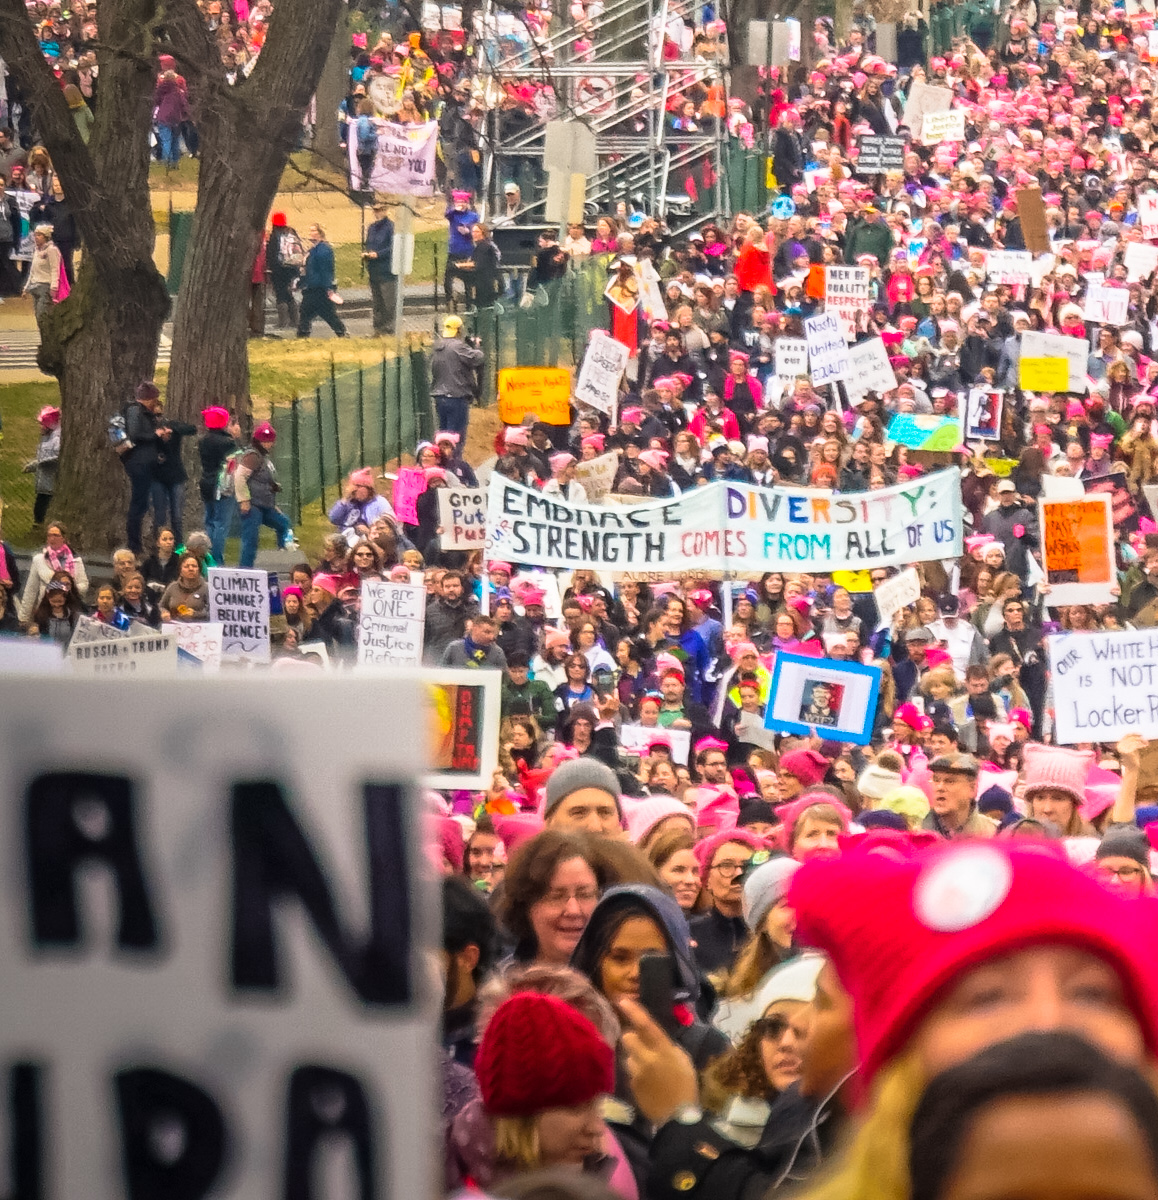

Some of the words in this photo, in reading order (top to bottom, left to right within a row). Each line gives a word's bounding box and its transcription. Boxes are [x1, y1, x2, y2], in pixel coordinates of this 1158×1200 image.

[829, 269, 850, 280] MEN
[828, 283, 867, 294] QUALITY
[828, 295, 868, 308] RESPECT
[808, 316, 838, 334] Nasty
[810, 336, 845, 357] United
[503, 485, 682, 529] EMBRACE
[727, 485, 937, 524] DIVERSITY:
[512, 520, 666, 563] STRENGTH
[681, 529, 748, 558] COMES
[763, 531, 831, 561] FROM
[845, 528, 896, 561] ALL
[907, 524, 925, 549] OF
[933, 518, 955, 544] US
[212, 576, 261, 594] CLIMATE
[366, 583, 387, 598] We
[391, 589, 415, 600] are
[214, 592, 264, 609] CHANGE?
[373, 600, 415, 618] ONE.
[217, 608, 261, 624] BELIEVE
[361, 617, 408, 633] Criminal
[222, 624, 269, 639] CIENCE!
[76, 644, 118, 660] RUSSIA
[132, 639, 170, 654] TRUMP
[362, 631, 415, 651] Justice
[1056, 649, 1082, 676] OUR
[1090, 637, 1146, 661] WHITE
[1079, 674, 1093, 688] IS
[1111, 663, 1157, 688] NOT
[1073, 695, 1145, 729] Locker
